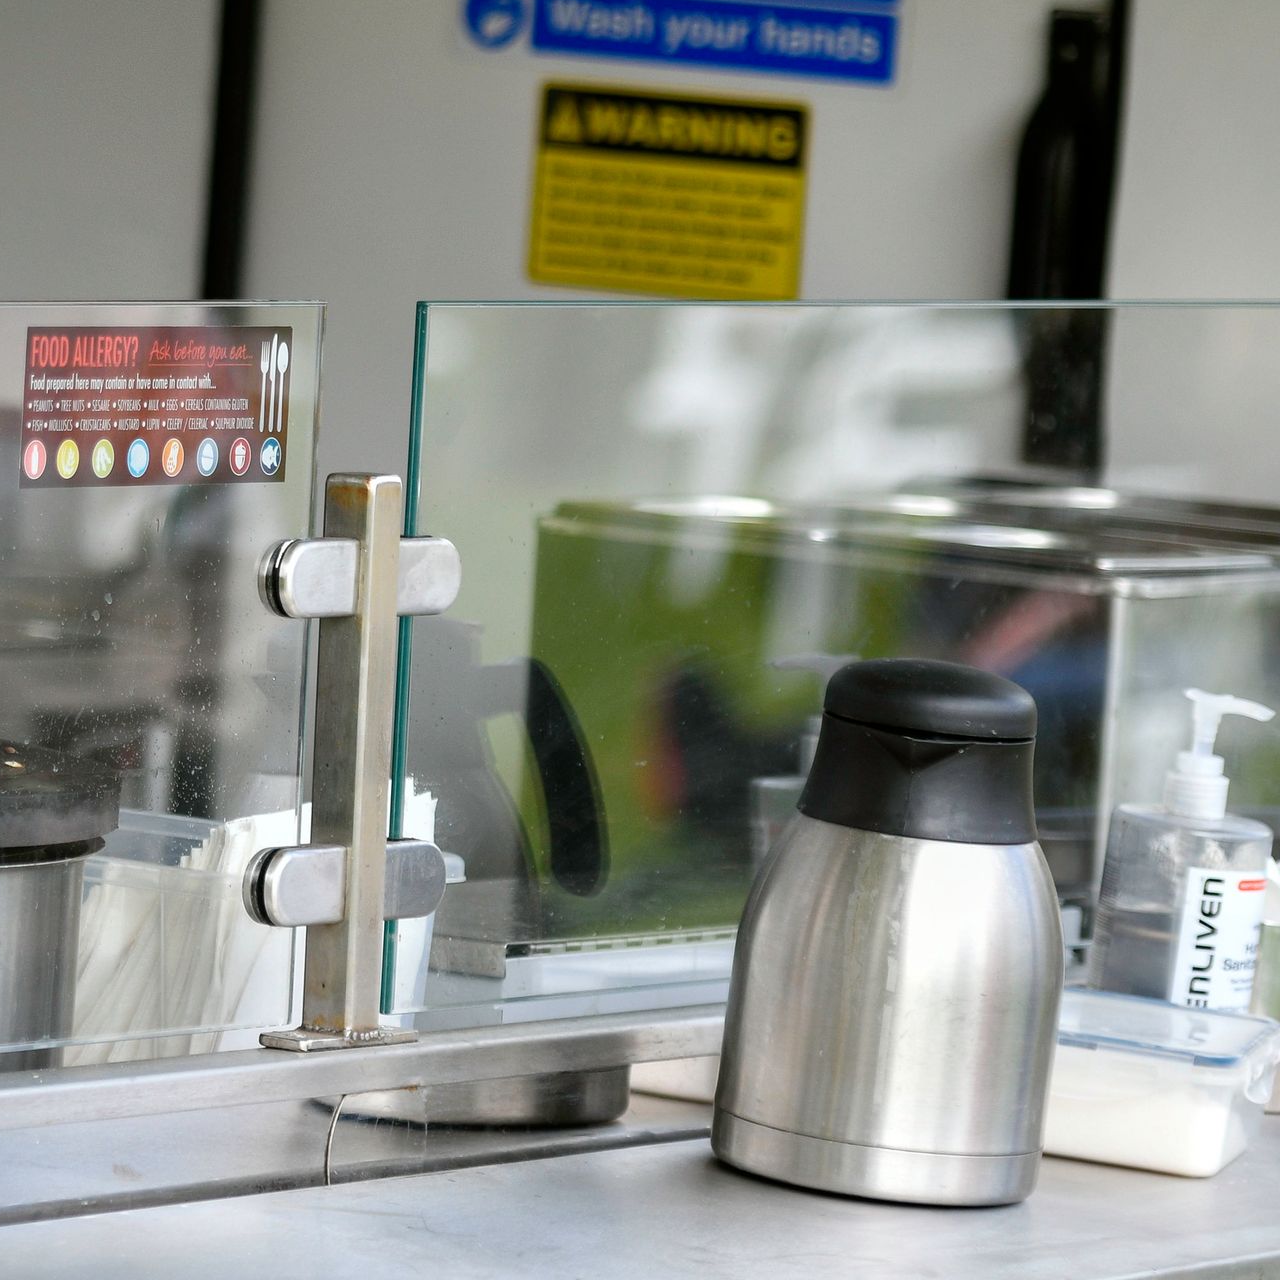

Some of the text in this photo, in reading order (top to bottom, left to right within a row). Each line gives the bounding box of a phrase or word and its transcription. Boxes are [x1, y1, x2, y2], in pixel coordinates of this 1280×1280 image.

[664, 14, 750, 53] your
[760, 13, 880, 63] hands
[588, 99, 798, 161] WARNING
[31, 335, 139, 368] FOOD ALLERGY?
[149, 340, 171, 361] Ask
[174, 339, 206, 361] before
[207, 345, 227, 368] you
[30, 373, 46, 390] Food
[46, 372, 75, 394] prepared
[75, 372, 89, 390] here
[90, 379, 104, 394] may
[105, 374, 128, 390] contain
[128, 380, 136, 390] or
[136, 372, 151, 389] have
[152, 379, 168, 389] come
[169, 375, 176, 389] in
[176, 375, 198, 389] contact
[33, 398, 249, 412] PEANUTS TREE NUTS SESAME SOYBEANS MILK EGGS CEREALS CONTAINING GLUTEN
[31, 419, 43, 431] FISH
[48, 419, 73, 432] MOLLUSCS
[80, 419, 111, 431] CRUSTACEANS
[118, 418, 140, 431] MUSTARD
[146, 418, 160, 430] LUPIN
[166, 418, 183, 430] CELERY
[188, 417, 208, 430] CELERIAC
[215, 417, 235, 429] SULPHUR
[236, 417, 254, 429] DIOXIDE
